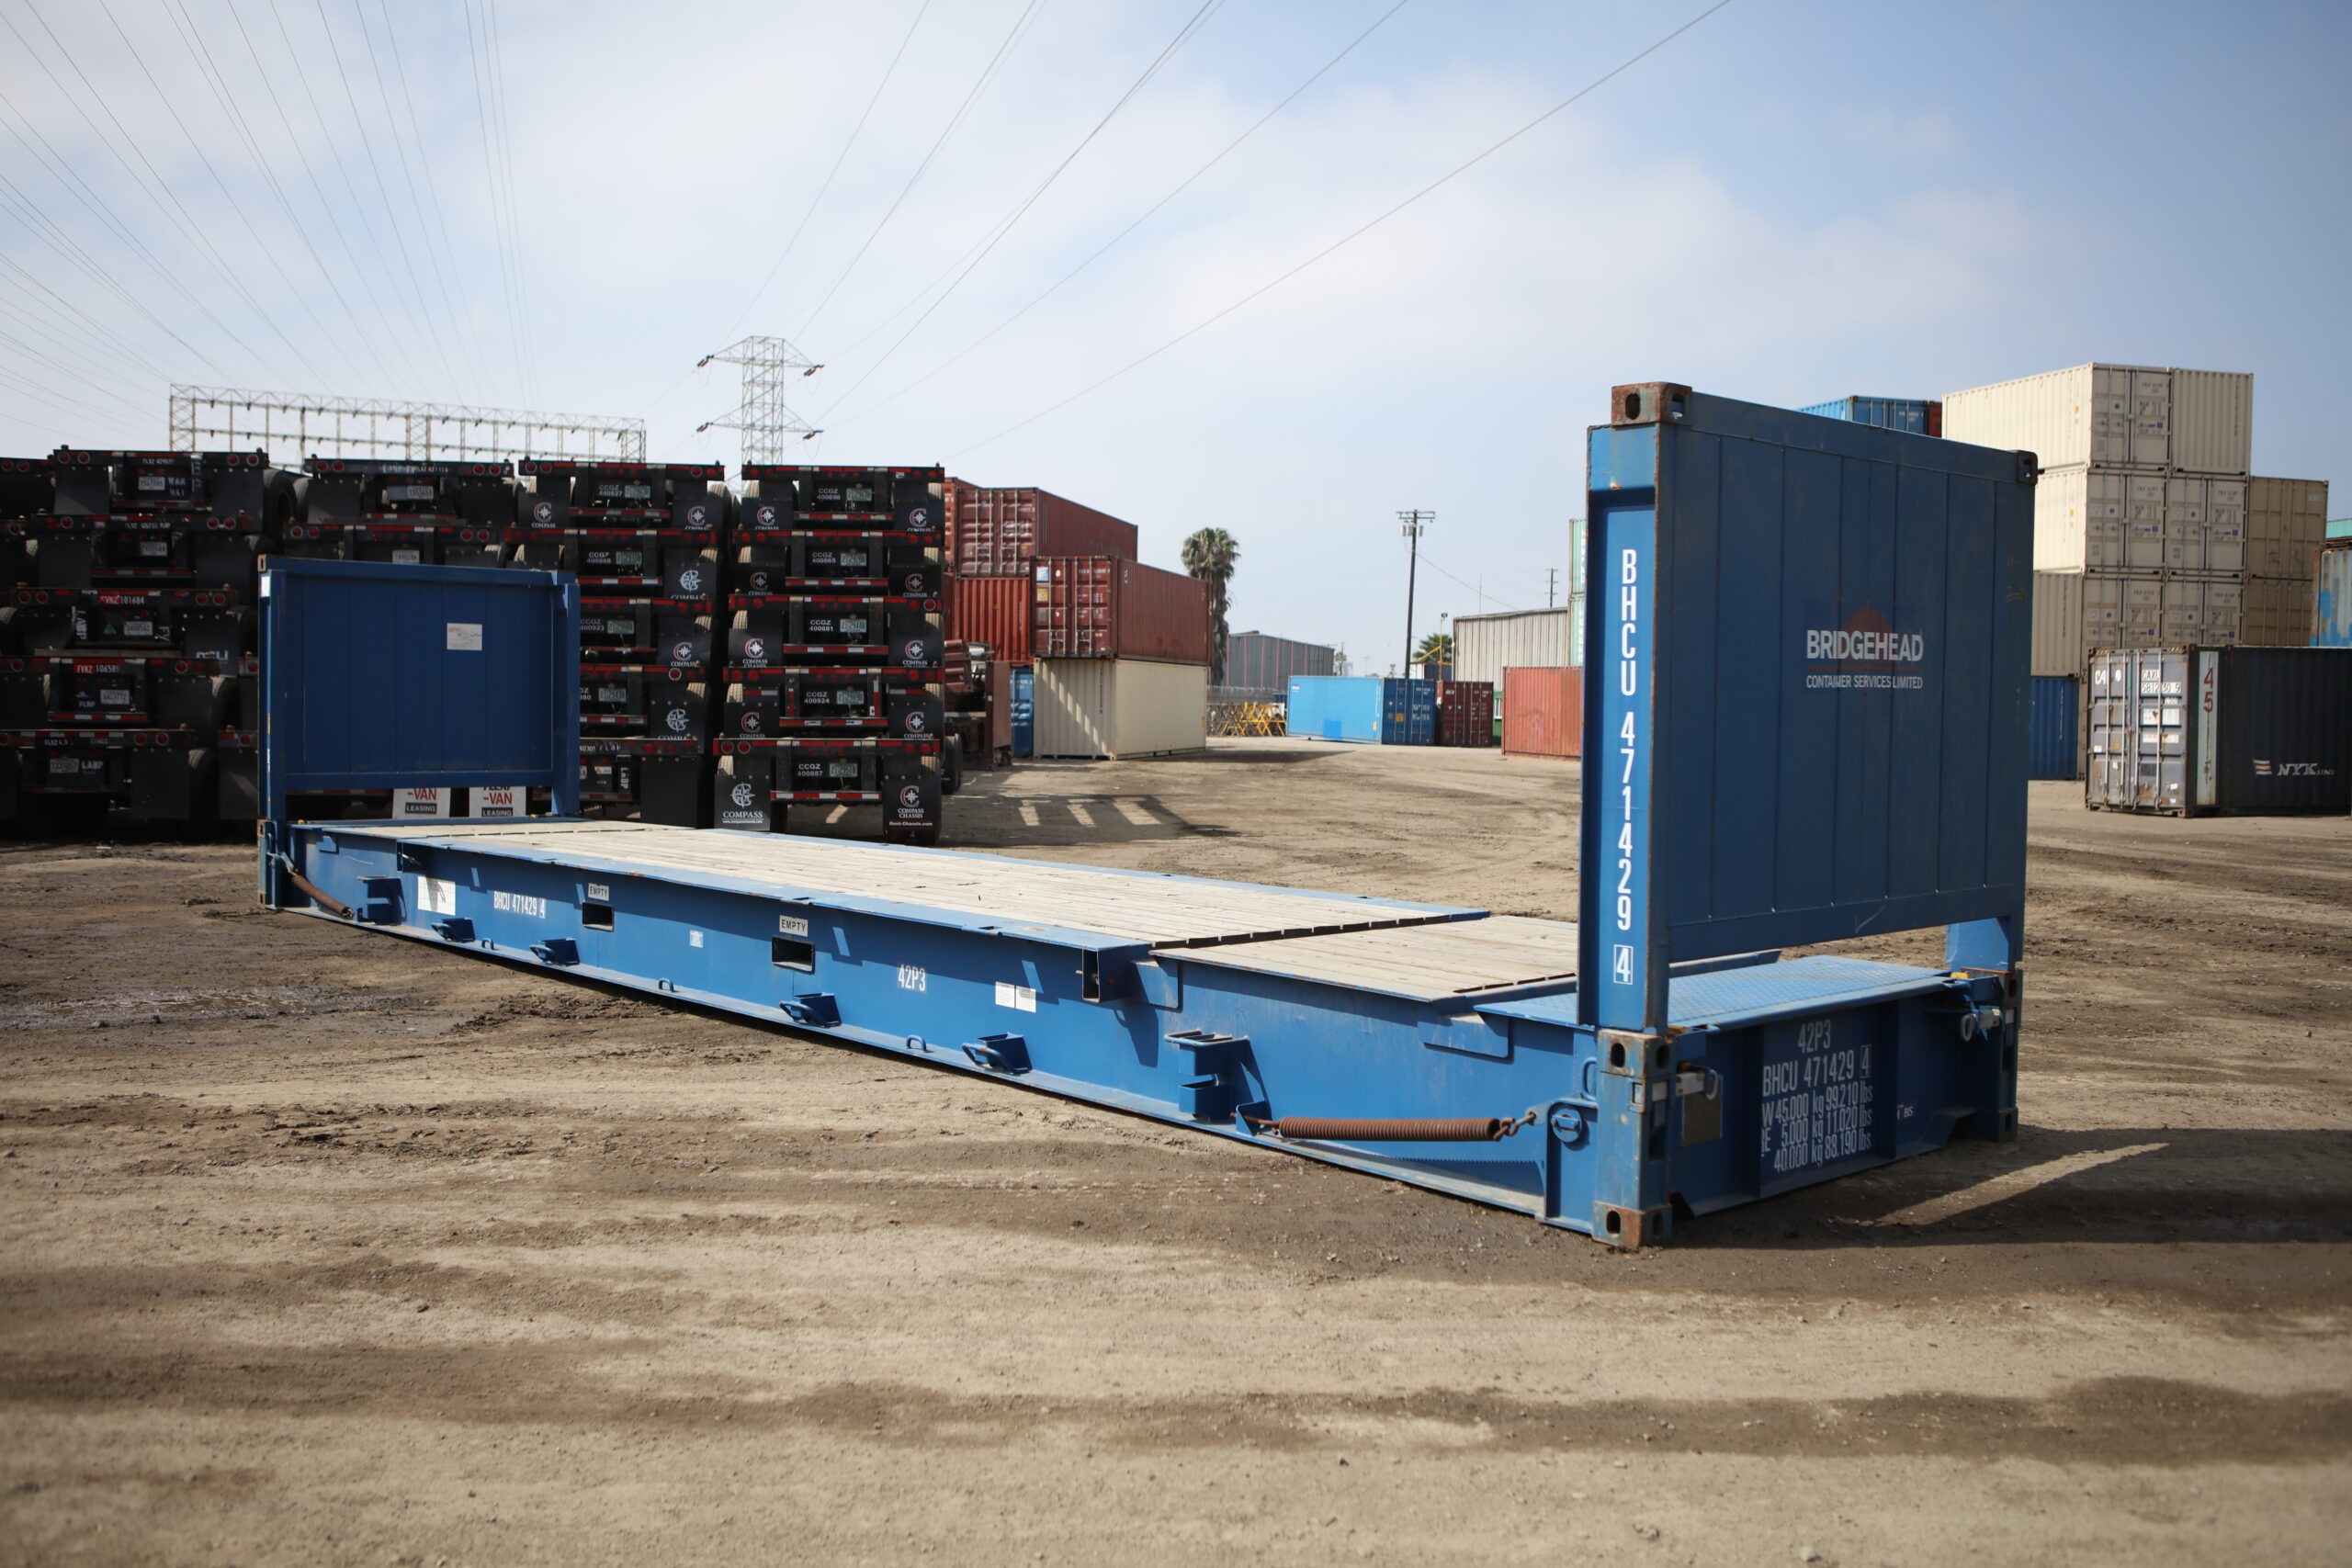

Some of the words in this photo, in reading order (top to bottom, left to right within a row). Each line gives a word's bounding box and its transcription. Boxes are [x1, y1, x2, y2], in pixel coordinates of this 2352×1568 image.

[1806, 629, 1924, 661] BRIDGEHEAD
[1806, 675, 1851, 689] CONTAINER
[1853, 675, 1892, 689] SERVICES
[1892, 676, 1924, 690] LIMITED
[2277, 762, 2319, 776] NYK
[493, 891, 510, 911] BHCU
[512, 894, 537, 917] 471429
[589, 886, 608, 898] EMPTY
[781, 919, 807, 932] EMPTY
[898, 964, 926, 992] 42P3
[1797, 1019, 1832, 1054] 42P3
[1762, 1059, 1798, 1098] BHCU
[1804, 1049, 1855, 1089] 471429
[1775, 1092, 1809, 1124] 45.000
[1812, 1089, 1825, 1119] kg
[1859, 1079, 1873, 1104] lbs
[1781, 1118, 1809, 1148] 5.000
[1812, 1115, 1824, 1144] kg
[1859, 1105, 1872, 1128] lbs
[1811, 1138, 1824, 1168] kg
[1858, 1127, 1872, 1152] lbs
